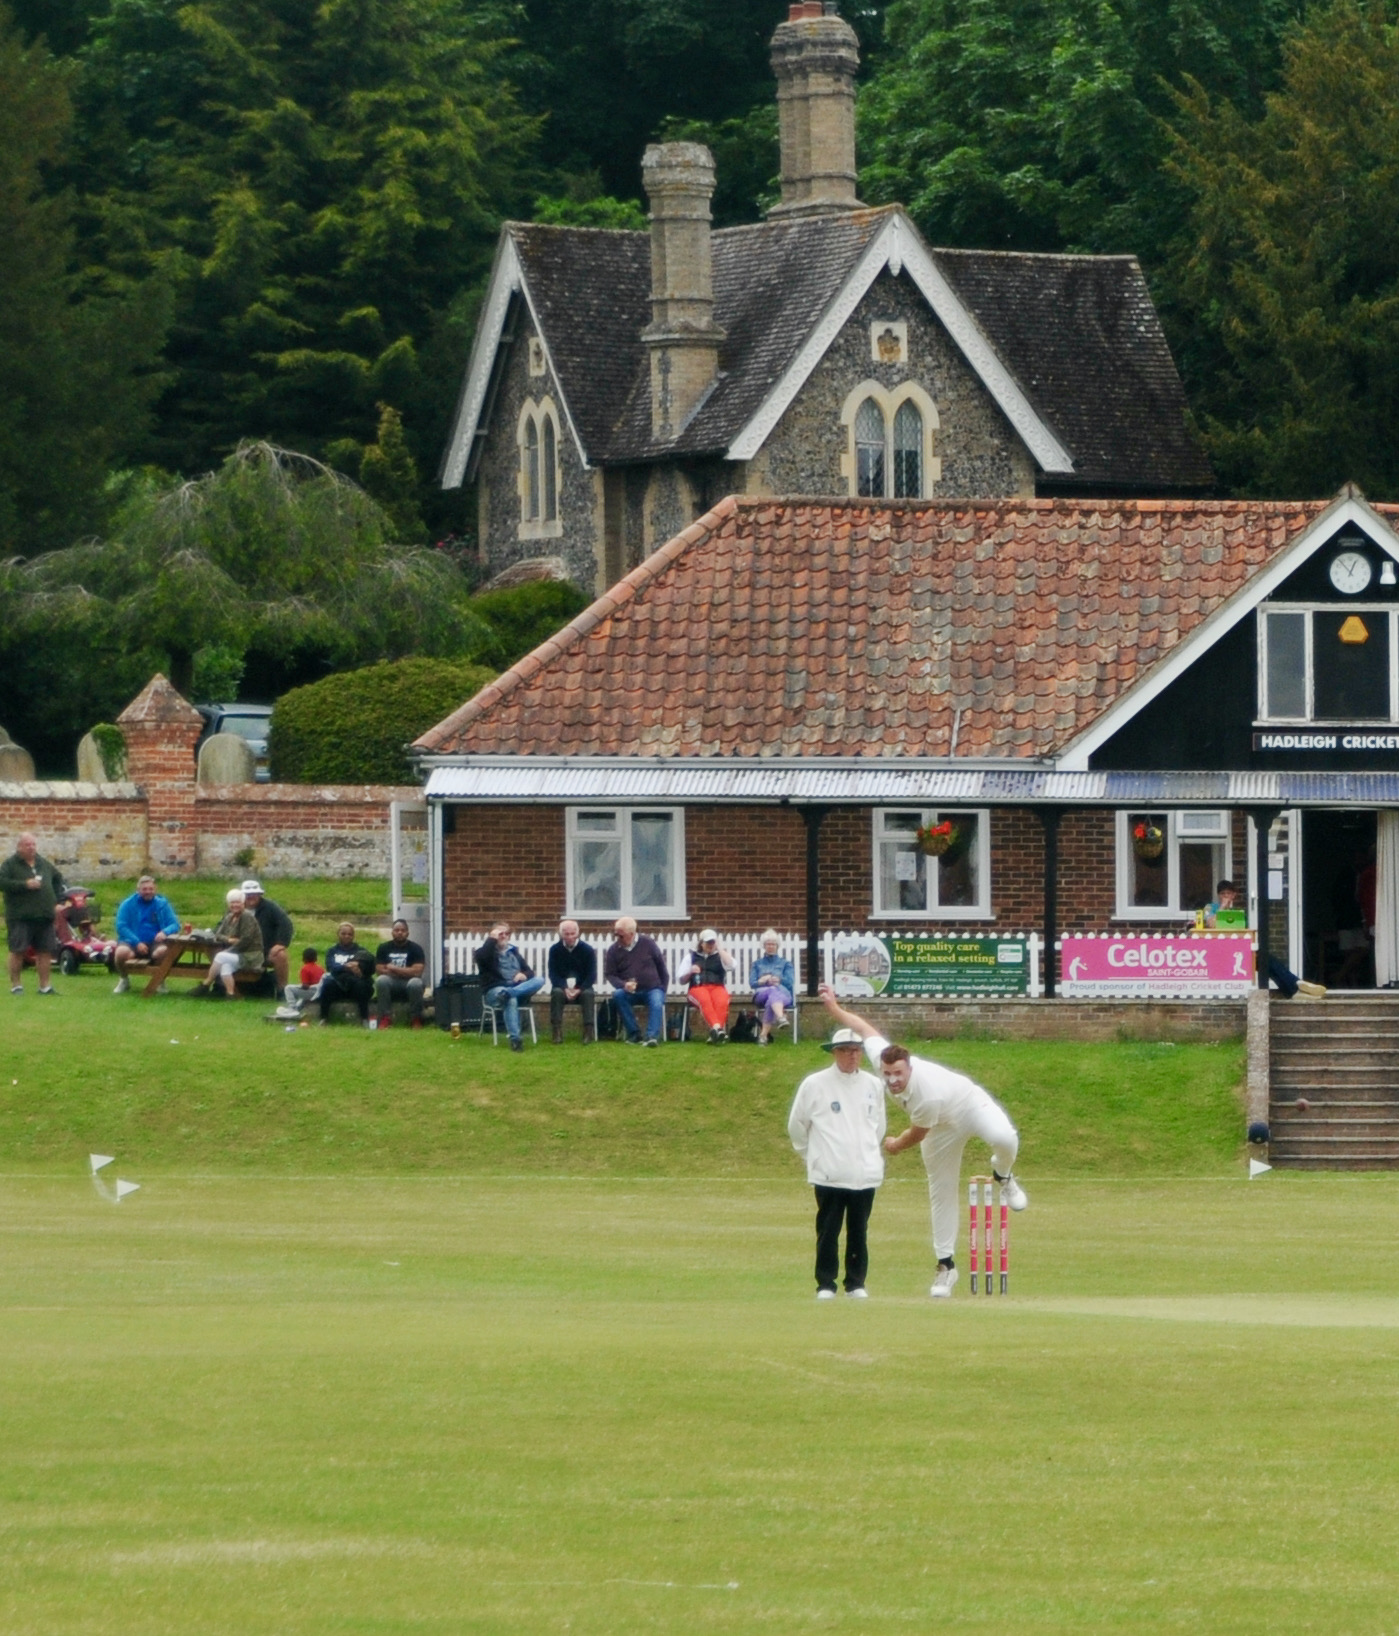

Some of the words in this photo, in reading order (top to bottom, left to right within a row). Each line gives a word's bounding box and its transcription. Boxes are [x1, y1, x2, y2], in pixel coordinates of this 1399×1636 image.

[1261, 735, 1337, 749] HADLEIGH
[893, 941, 914, 953] Top
[917, 941, 954, 954] quality
[957, 943, 980, 952] care
[893, 953, 904, 963] in
[907, 955, 913, 963] a
[916, 953, 956, 963] relaxed
[958, 953, 996, 965] setting
[1107, 944, 1208, 968] Celotex
[1147, 968, 1208, 977] SAINT-GOBAIN
[1148, 983, 1187, 991] Hadleigh
